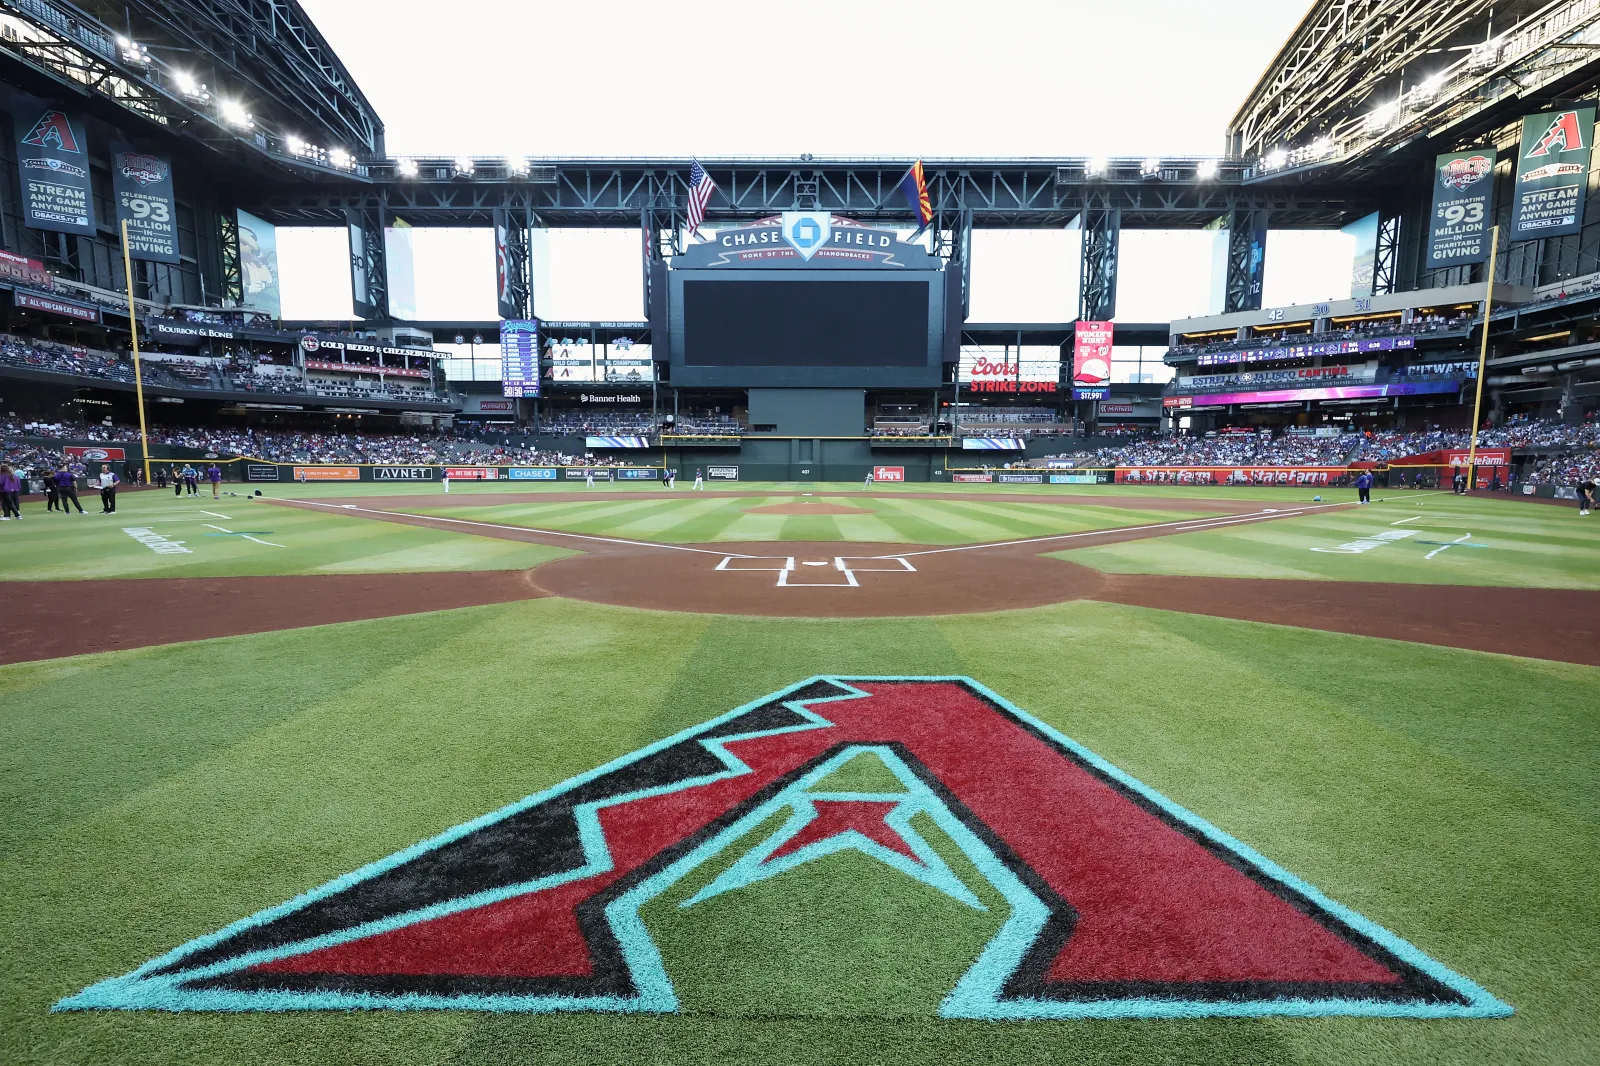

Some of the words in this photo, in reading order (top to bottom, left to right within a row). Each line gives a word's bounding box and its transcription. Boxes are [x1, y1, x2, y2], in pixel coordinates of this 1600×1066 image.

[28, 182, 86, 200] STREAM
[120, 191, 168, 203] CELEBRATING
[1522, 188, 1578, 204] STREAM
[30, 193, 52, 202] ANY
[56, 196, 86, 208] GAME
[1438, 196, 1486, 208] CELEBRATING
[1520, 203, 1544, 212] ANY
[1546, 198, 1577, 209] GAME
[31, 202, 87, 216] ANYWHERE
[122, 198, 170, 222] $93
[1437, 202, 1484, 226] $93
[1520, 207, 1576, 220] ANYWHERE
[34, 211, 75, 222] DBACKS.TV
[123, 218, 171, 232] MILLION
[1434, 222, 1482, 236] MILLION
[1521, 220, 1561, 230] DBACKS.TV
[722, 232, 779, 247] CHASE
[834, 231, 890, 247] FIELD
[1434, 239, 1481, 250] CHARITABLE
[128, 241, 173, 254] GIVING
[818, 250, 870, 259] DIAMONDBACKS
[1432, 246, 1480, 260] GIVING
[30, 299, 72, 313] ALL-YOU-CAN-EAT
[73, 308, 88, 317] SEATS
[1311, 304, 1330, 316] 20
[1354, 299, 1370, 312] 51
[1268, 309, 1284, 320] 42
[320, 341, 344, 349] COLD
[346, 343, 375, 352] BEERS
[383, 347, 452, 360] CHEESEBURGERS
[971, 357, 1019, 375] Coors
[1192, 376, 1240, 385] ESTRELLA
[1254, 371, 1296, 382] JALISCO
[1298, 366, 1348, 378] CANTINA
[970, 381, 1016, 392] STRIKE
[1019, 381, 1056, 392] ZONE
[381, 469, 426, 478] AVNET
[878, 468, 900, 480] fry's
